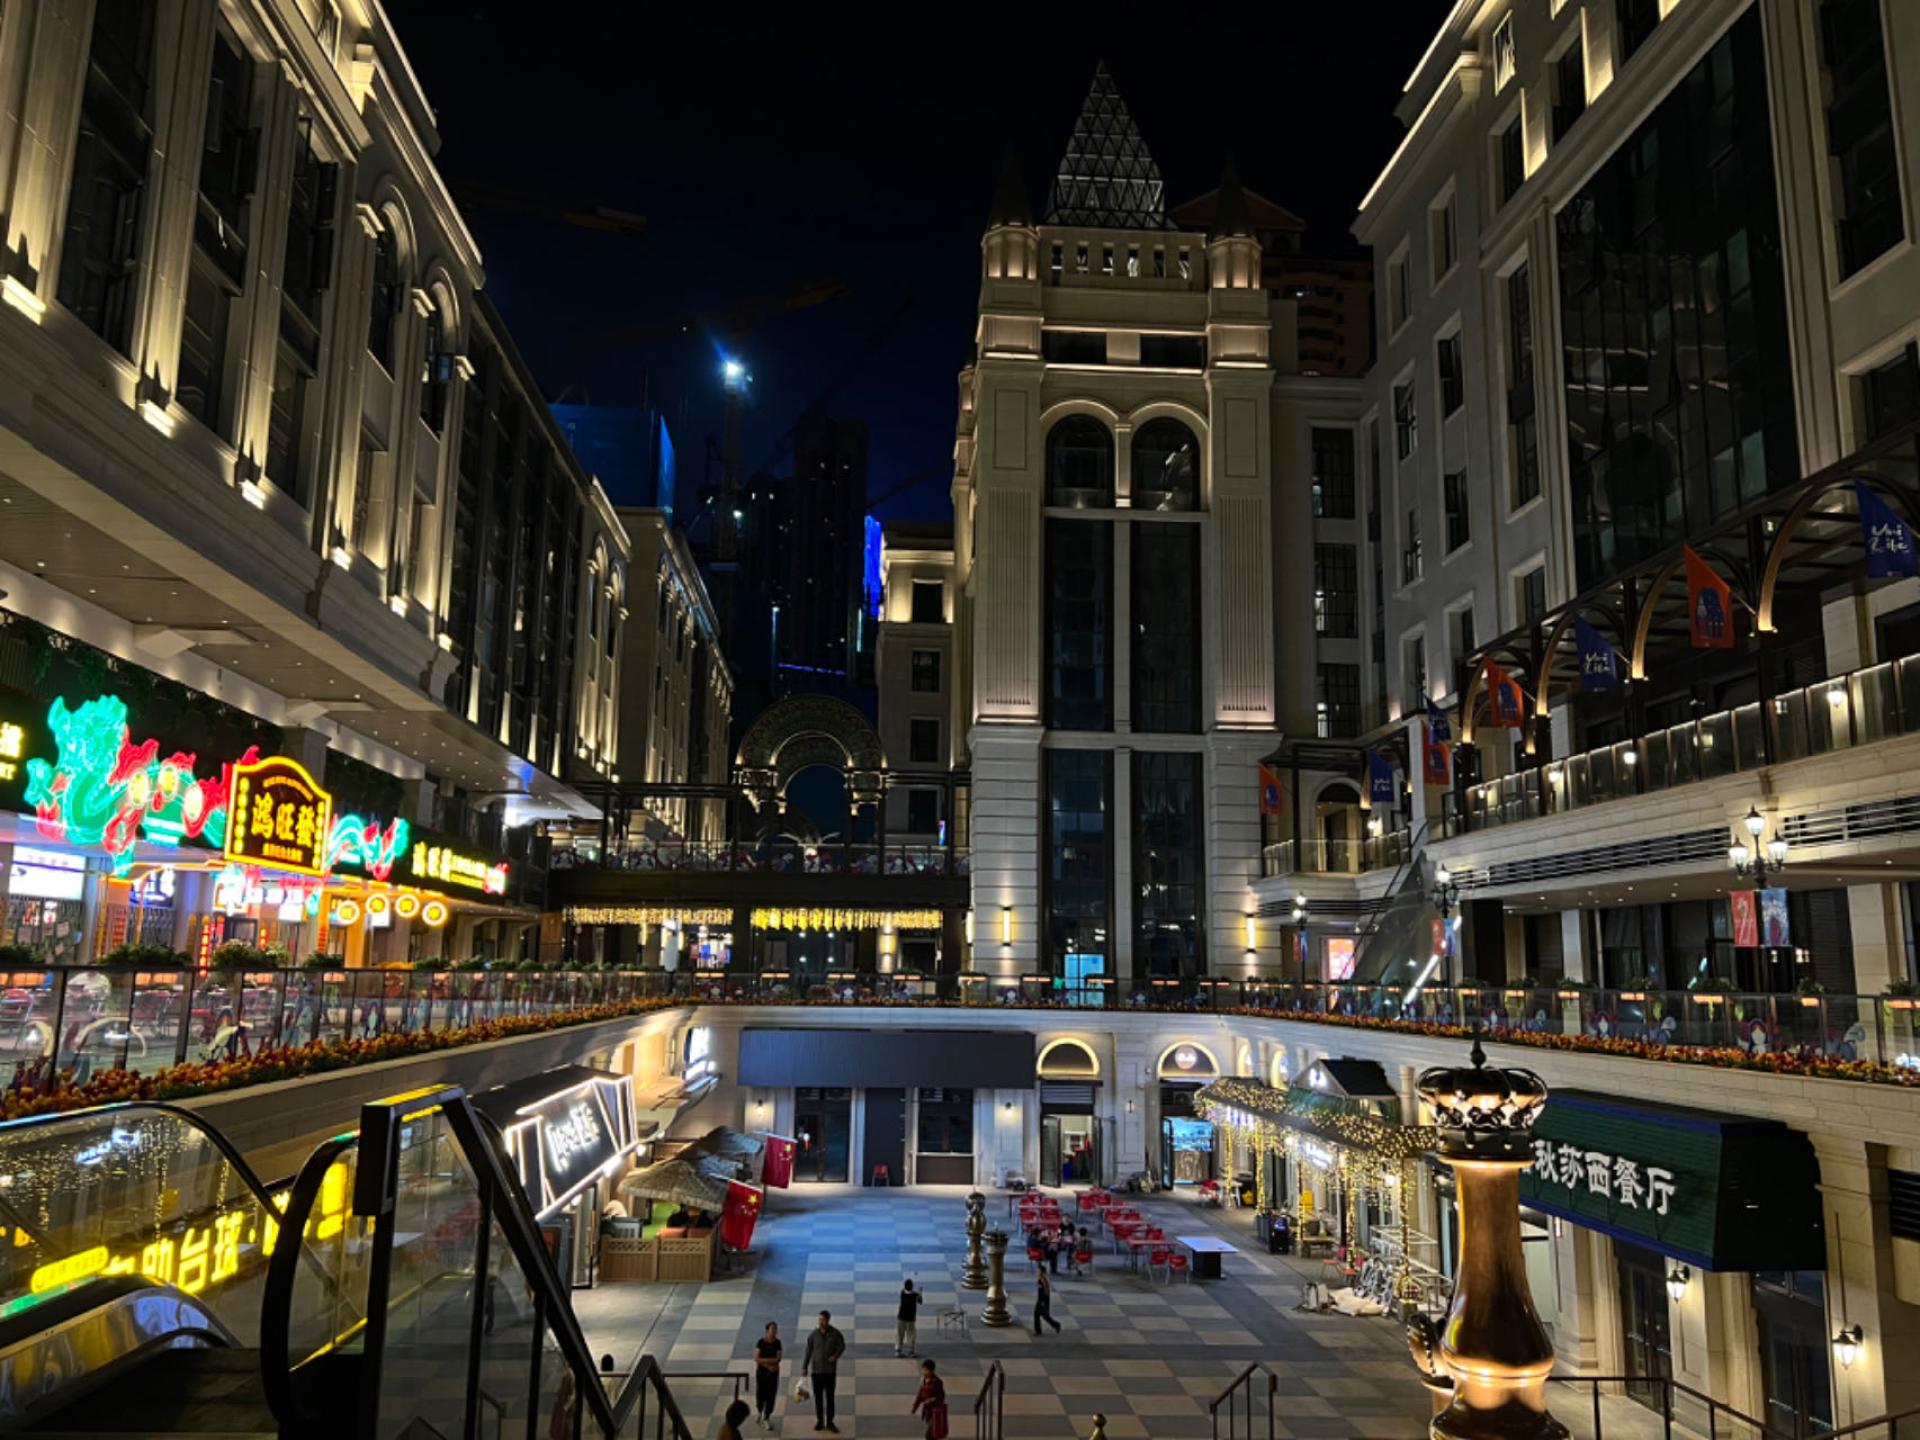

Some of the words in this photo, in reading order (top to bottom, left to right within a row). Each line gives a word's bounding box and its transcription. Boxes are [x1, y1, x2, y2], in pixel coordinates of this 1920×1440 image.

[1521, 1139, 1676, 1216] 秋莎西餐厅
